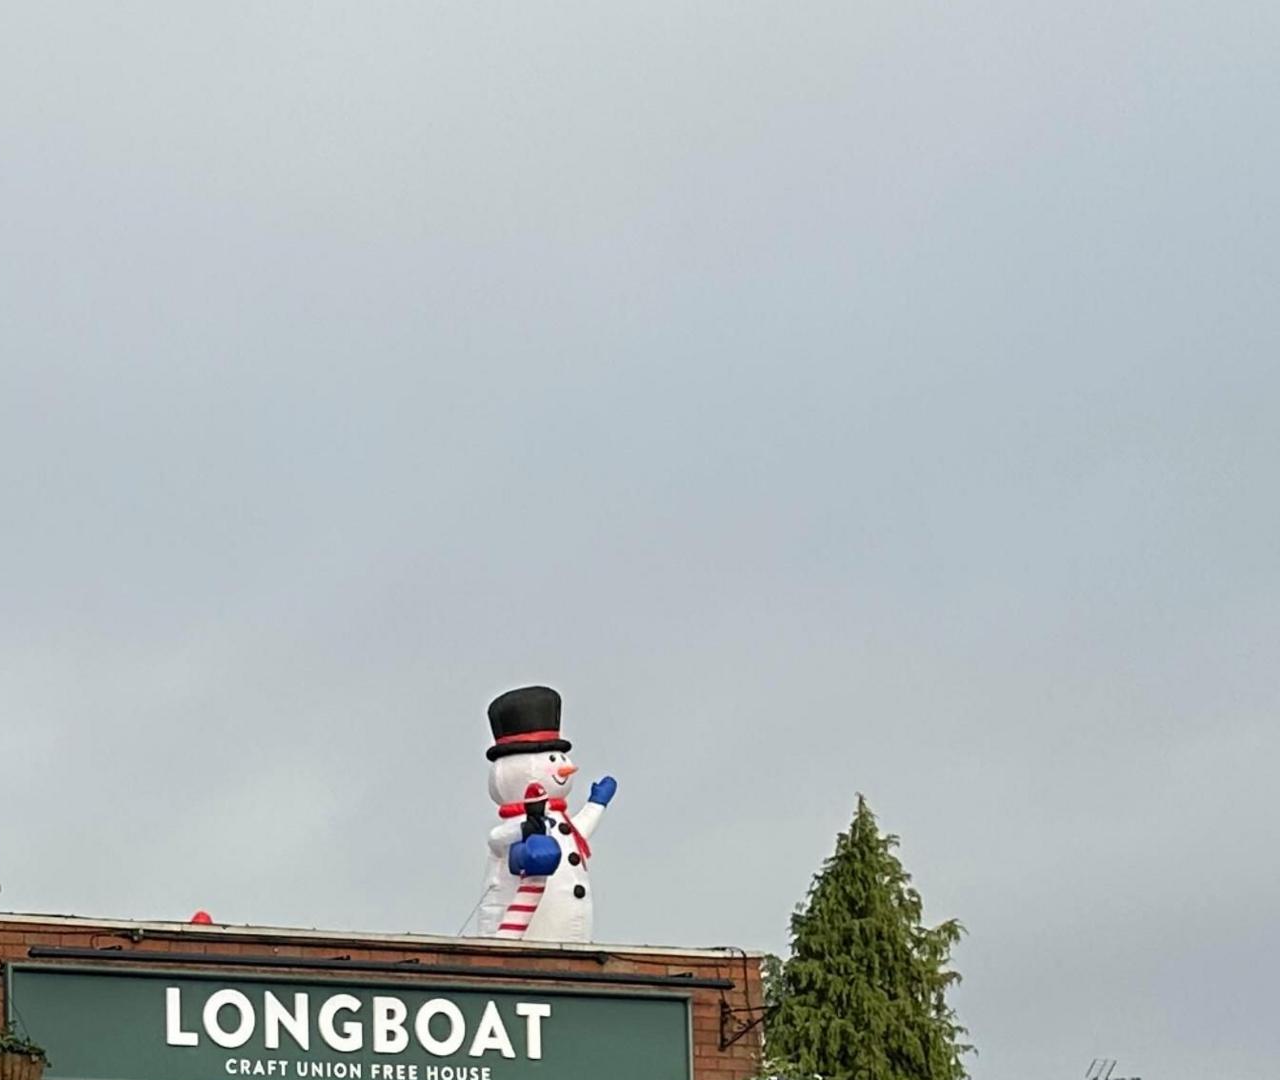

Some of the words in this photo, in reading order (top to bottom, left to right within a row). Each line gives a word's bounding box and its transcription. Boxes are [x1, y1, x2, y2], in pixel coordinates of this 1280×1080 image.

[166, 986, 552, 1060] LONGBOAT
[225, 1058, 289, 1077] CRAFT
[296, 1061, 363, 1080] UNION
